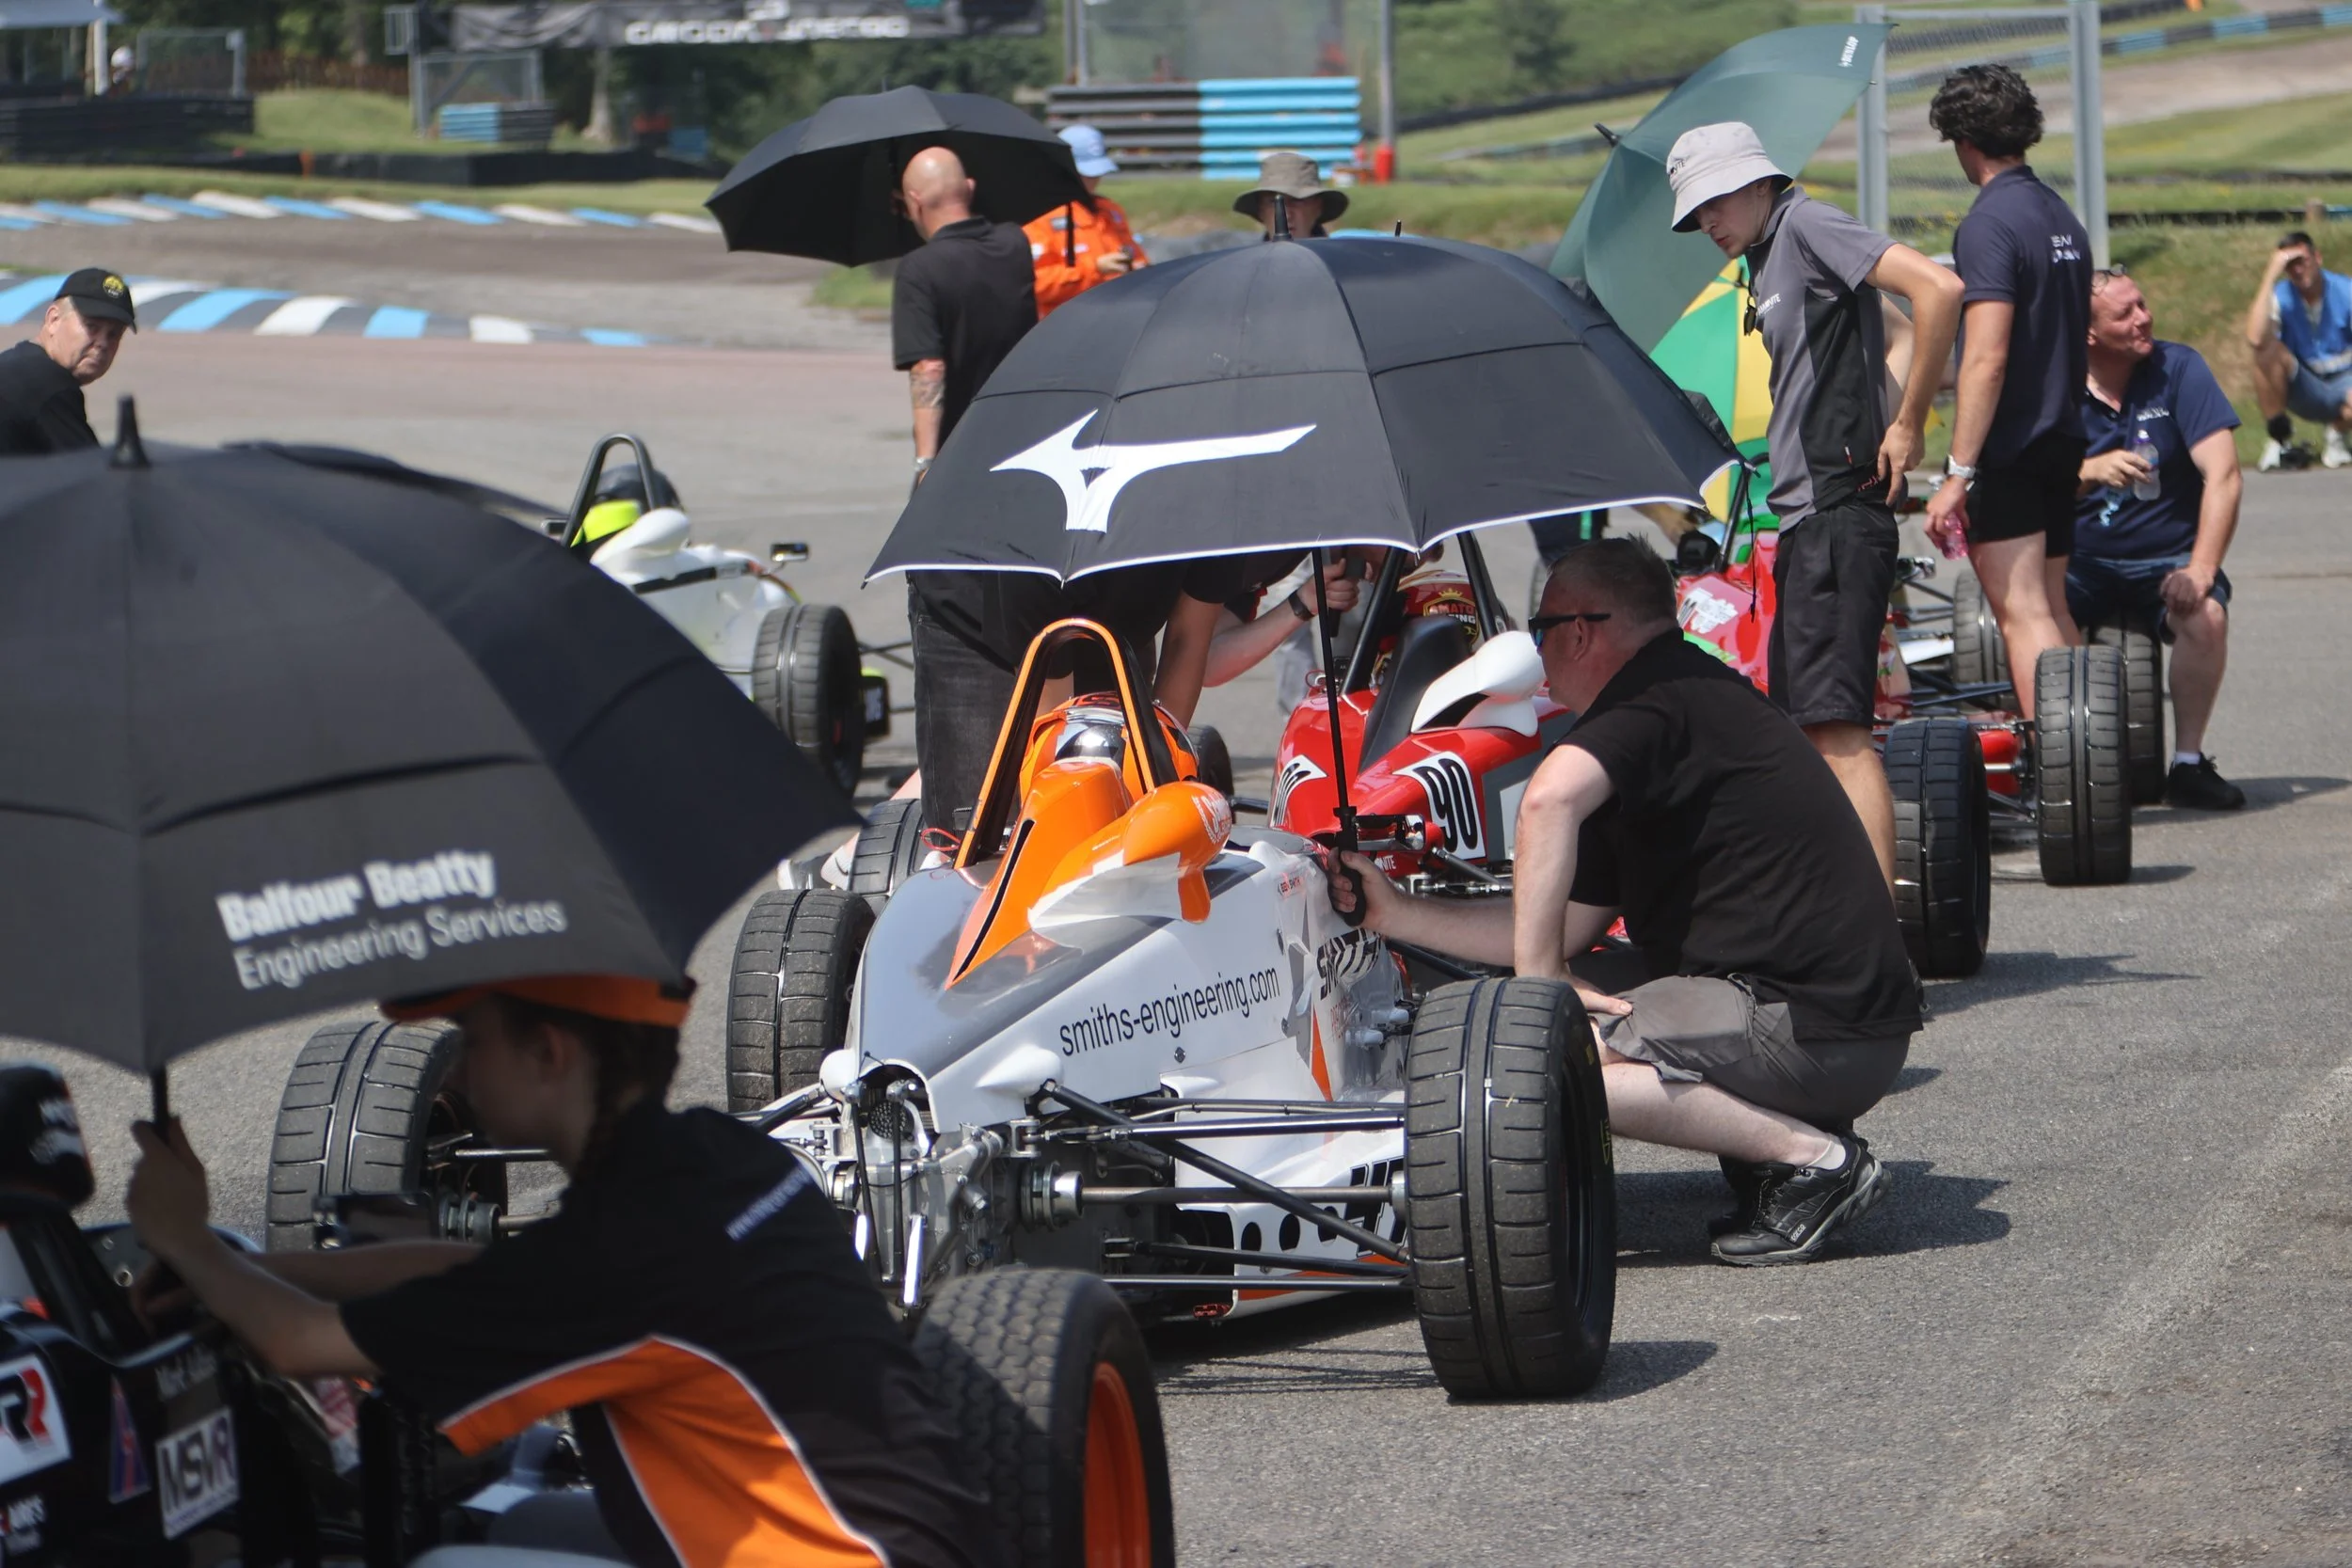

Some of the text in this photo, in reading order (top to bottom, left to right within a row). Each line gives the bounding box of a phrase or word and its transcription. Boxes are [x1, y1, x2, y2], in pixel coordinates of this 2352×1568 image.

[1840, 36, 1859, 63] DUNLOP
[1412, 758, 1479, 853] 90
[216, 849, 497, 942] Balfour Beatty
[232, 897, 568, 990] Engineering Services
[1059, 967, 1280, 1056] smiths-engineering.com
